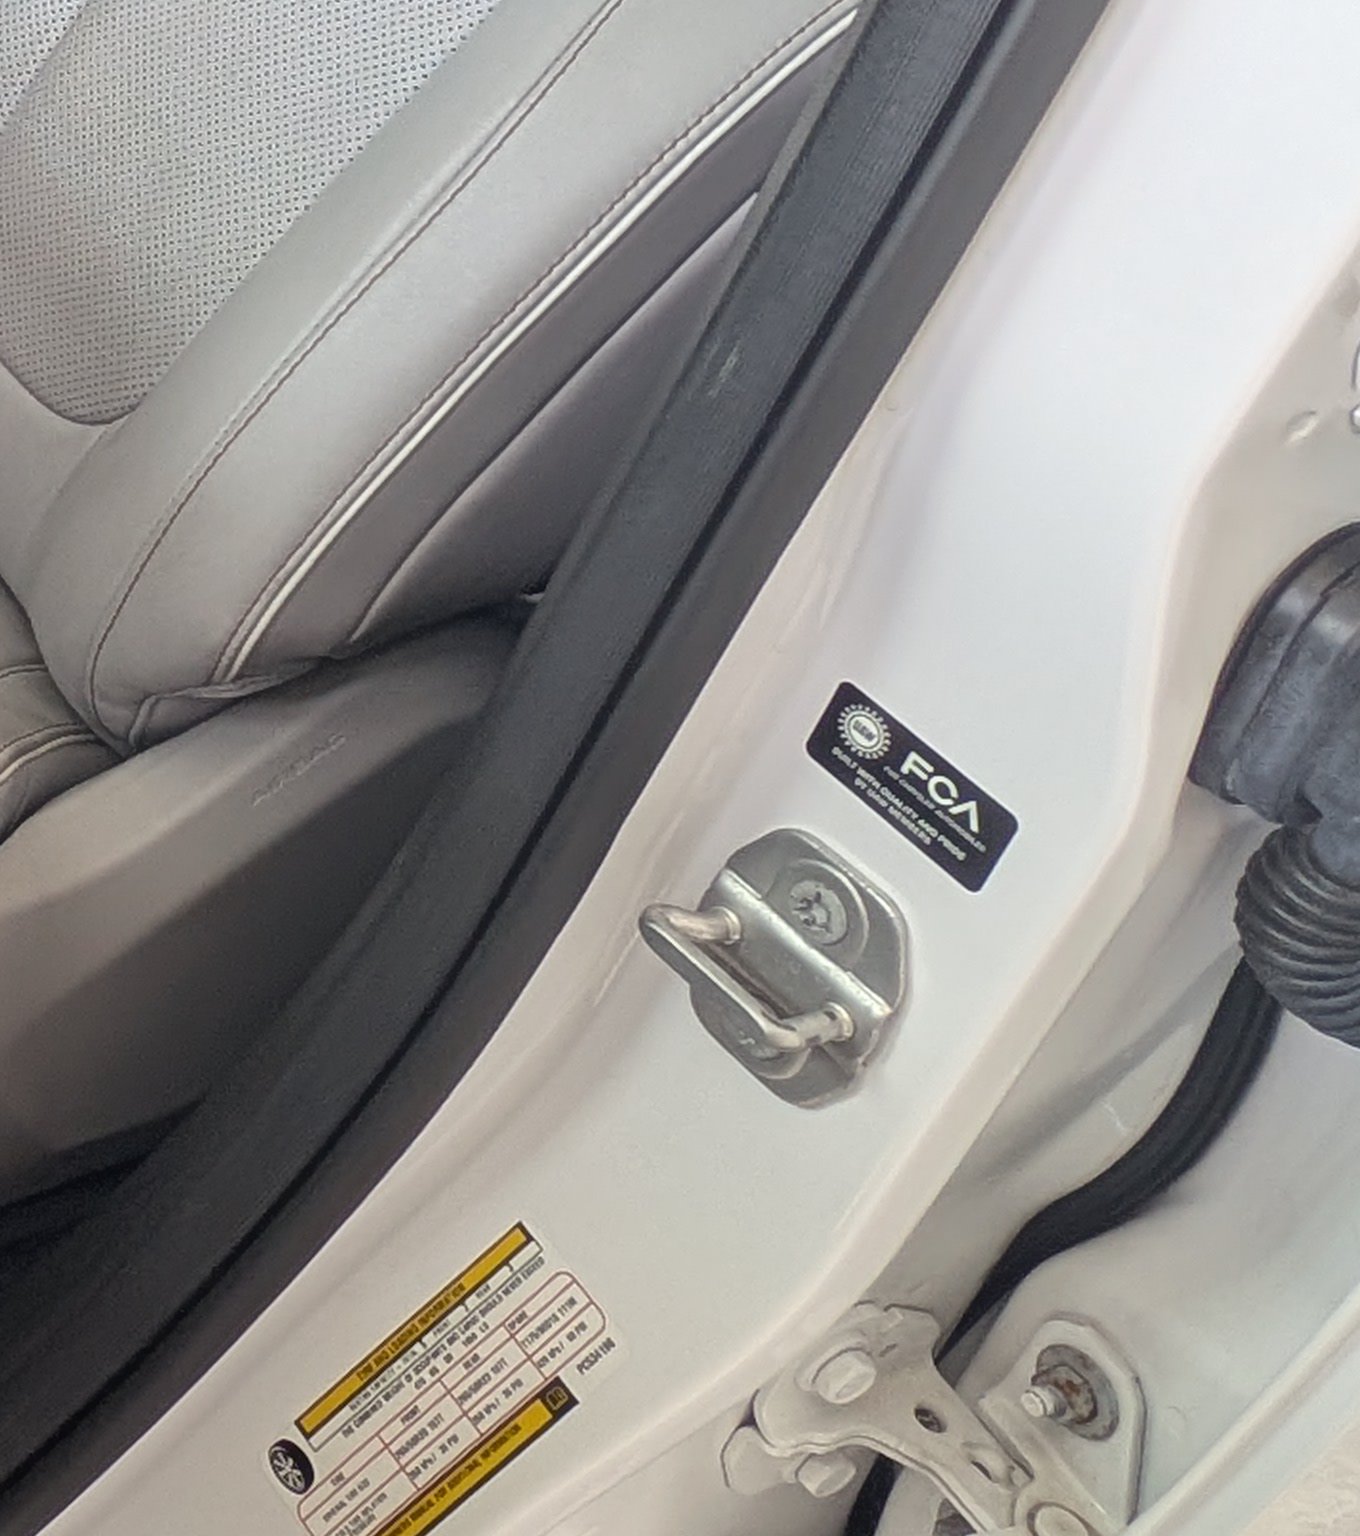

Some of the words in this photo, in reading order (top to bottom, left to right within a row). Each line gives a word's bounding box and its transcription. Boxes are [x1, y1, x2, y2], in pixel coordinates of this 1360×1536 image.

[830, 745, 858, 771] BUILT
[854, 765, 882, 791] WITH
[877, 784, 919, 822] QUALITY
[916, 815, 940, 839] AND
[936, 832, 968, 862] PRIDE
[865, 786, 889, 809] UAW
[886, 804, 933, 846] MEMBERS
[897, 748, 990, 835] FCA
